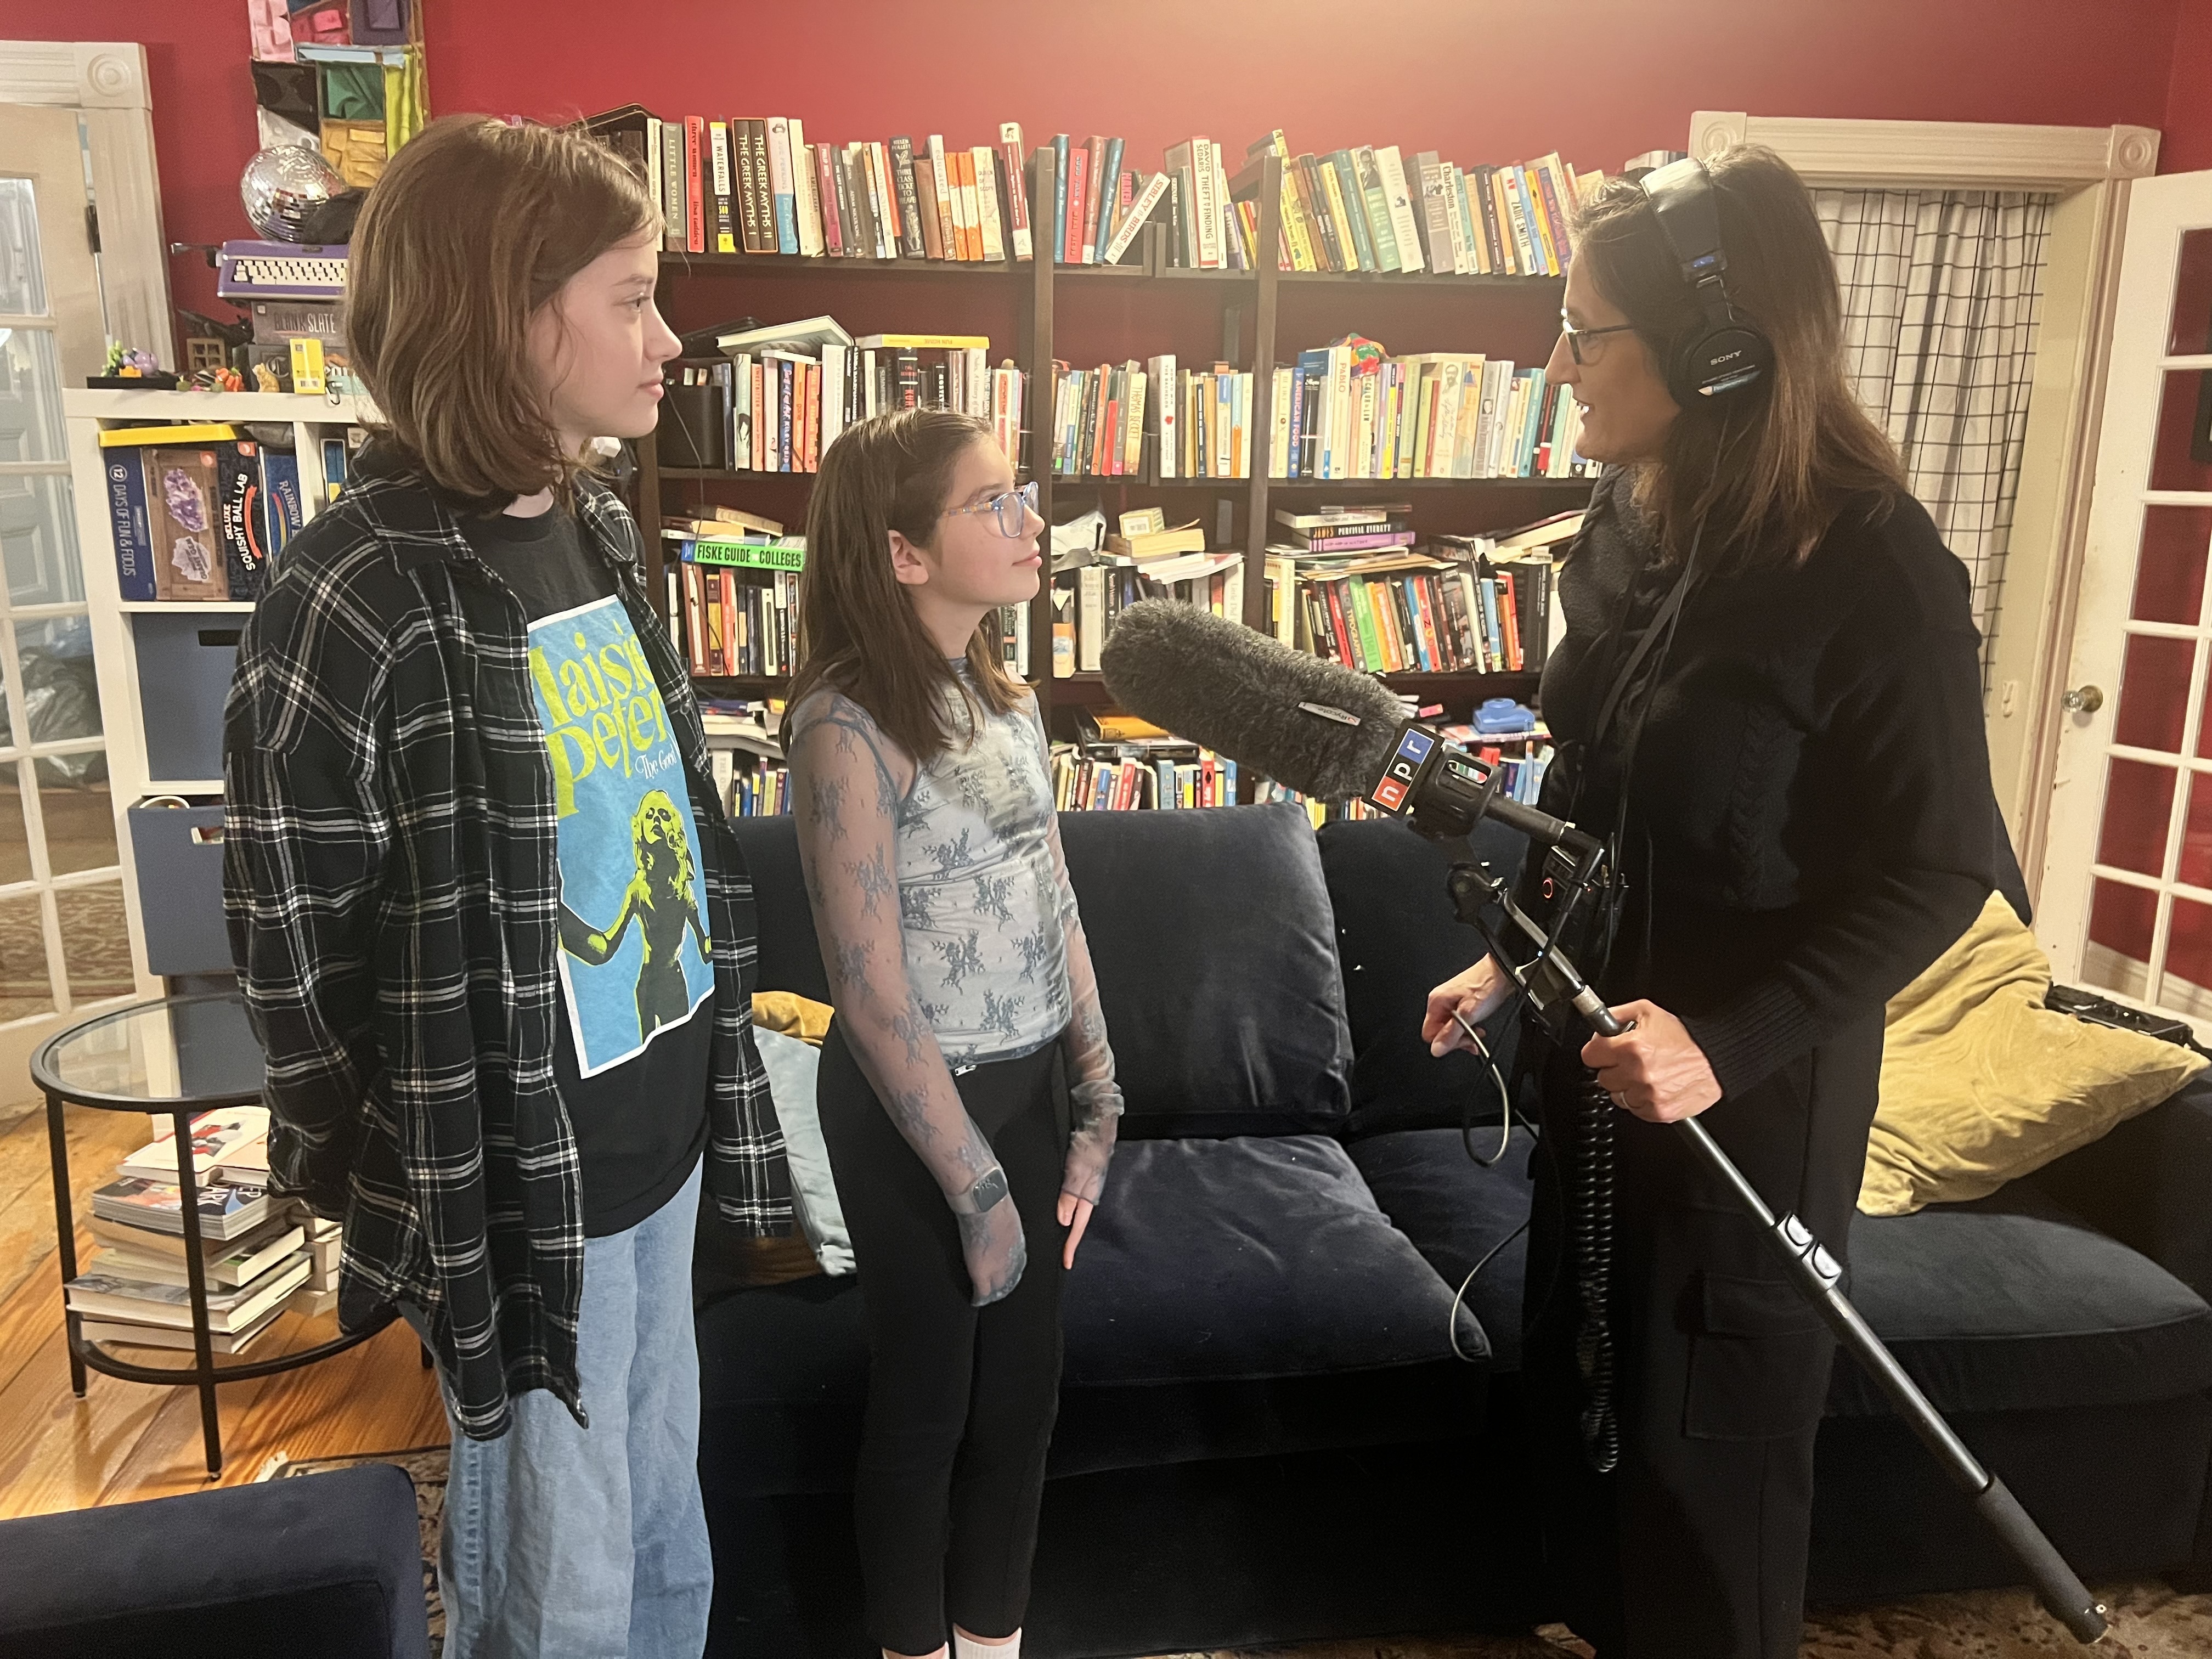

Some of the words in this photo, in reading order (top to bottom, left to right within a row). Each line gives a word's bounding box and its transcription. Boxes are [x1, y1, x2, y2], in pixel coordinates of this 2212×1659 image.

[669, 139, 677, 176] LITTLE
[740, 134, 749, 156] THE
[754, 134, 765, 156] THE
[1196, 144, 1205, 172] SEDARIS
[716, 146, 726, 191] WATERFALLS
[741, 158, 752, 189] GREEK
[756, 158, 768, 189] GREEK
[935, 149, 947, 194] educated
[1141, 179, 1164, 211] SIBLEY
[1201, 176, 1210, 201] THEFT
[1442, 166, 1455, 208] Charleston
[744, 192, 756, 227] MYTHS
[757, 191, 771, 227] MYTHS
[1511, 201, 1524, 221] ZADIE
[1120, 216, 1140, 243] BIRDS
[1204, 207, 1214, 239] FINDING
[1516, 223, 1531, 248] SMITH
[274, 314, 306, 331] BLANK
[307, 313, 336, 334] SLATE
[1710, 350, 1742, 366] SONY
[1130, 386, 1143, 413] THOMAS
[1293, 380, 1302, 422] AMERICAN
[1127, 415, 1141, 440] BECKET
[114, 468, 123, 478] 12
[233, 473, 248, 494] LAB
[113, 484, 128, 507] DAYS
[279, 480, 301, 527] RAINBOW
[116, 508, 129, 519] OF
[223, 504, 234, 540] DELUXE
[232, 497, 242, 523] BALL
[117, 520, 131, 538] FUN
[1313, 526, 1334, 538] JAMES
[1338, 525, 1364, 535] PERCIVAL
[1366, 524, 1391, 534] EVERETT
[120, 538, 132, 548] &
[185, 538, 198, 556] GEM
[233, 525, 256, 571] SQUISHY
[697, 544, 723, 561] FISKE
[724, 547, 751, 563] GUIDE
[759, 550, 802, 567] COLLEGES
[121, 548, 136, 578] FOCUS
[193, 556, 208, 580] GIANT
[1346, 608, 1363, 657] TYPOGRAPHY
[1317, 706, 1347, 720] Rycote
[635, 754, 659, 780] The
[658, 744, 678, 771] Good
[1380, 740, 1421, 802] npr
